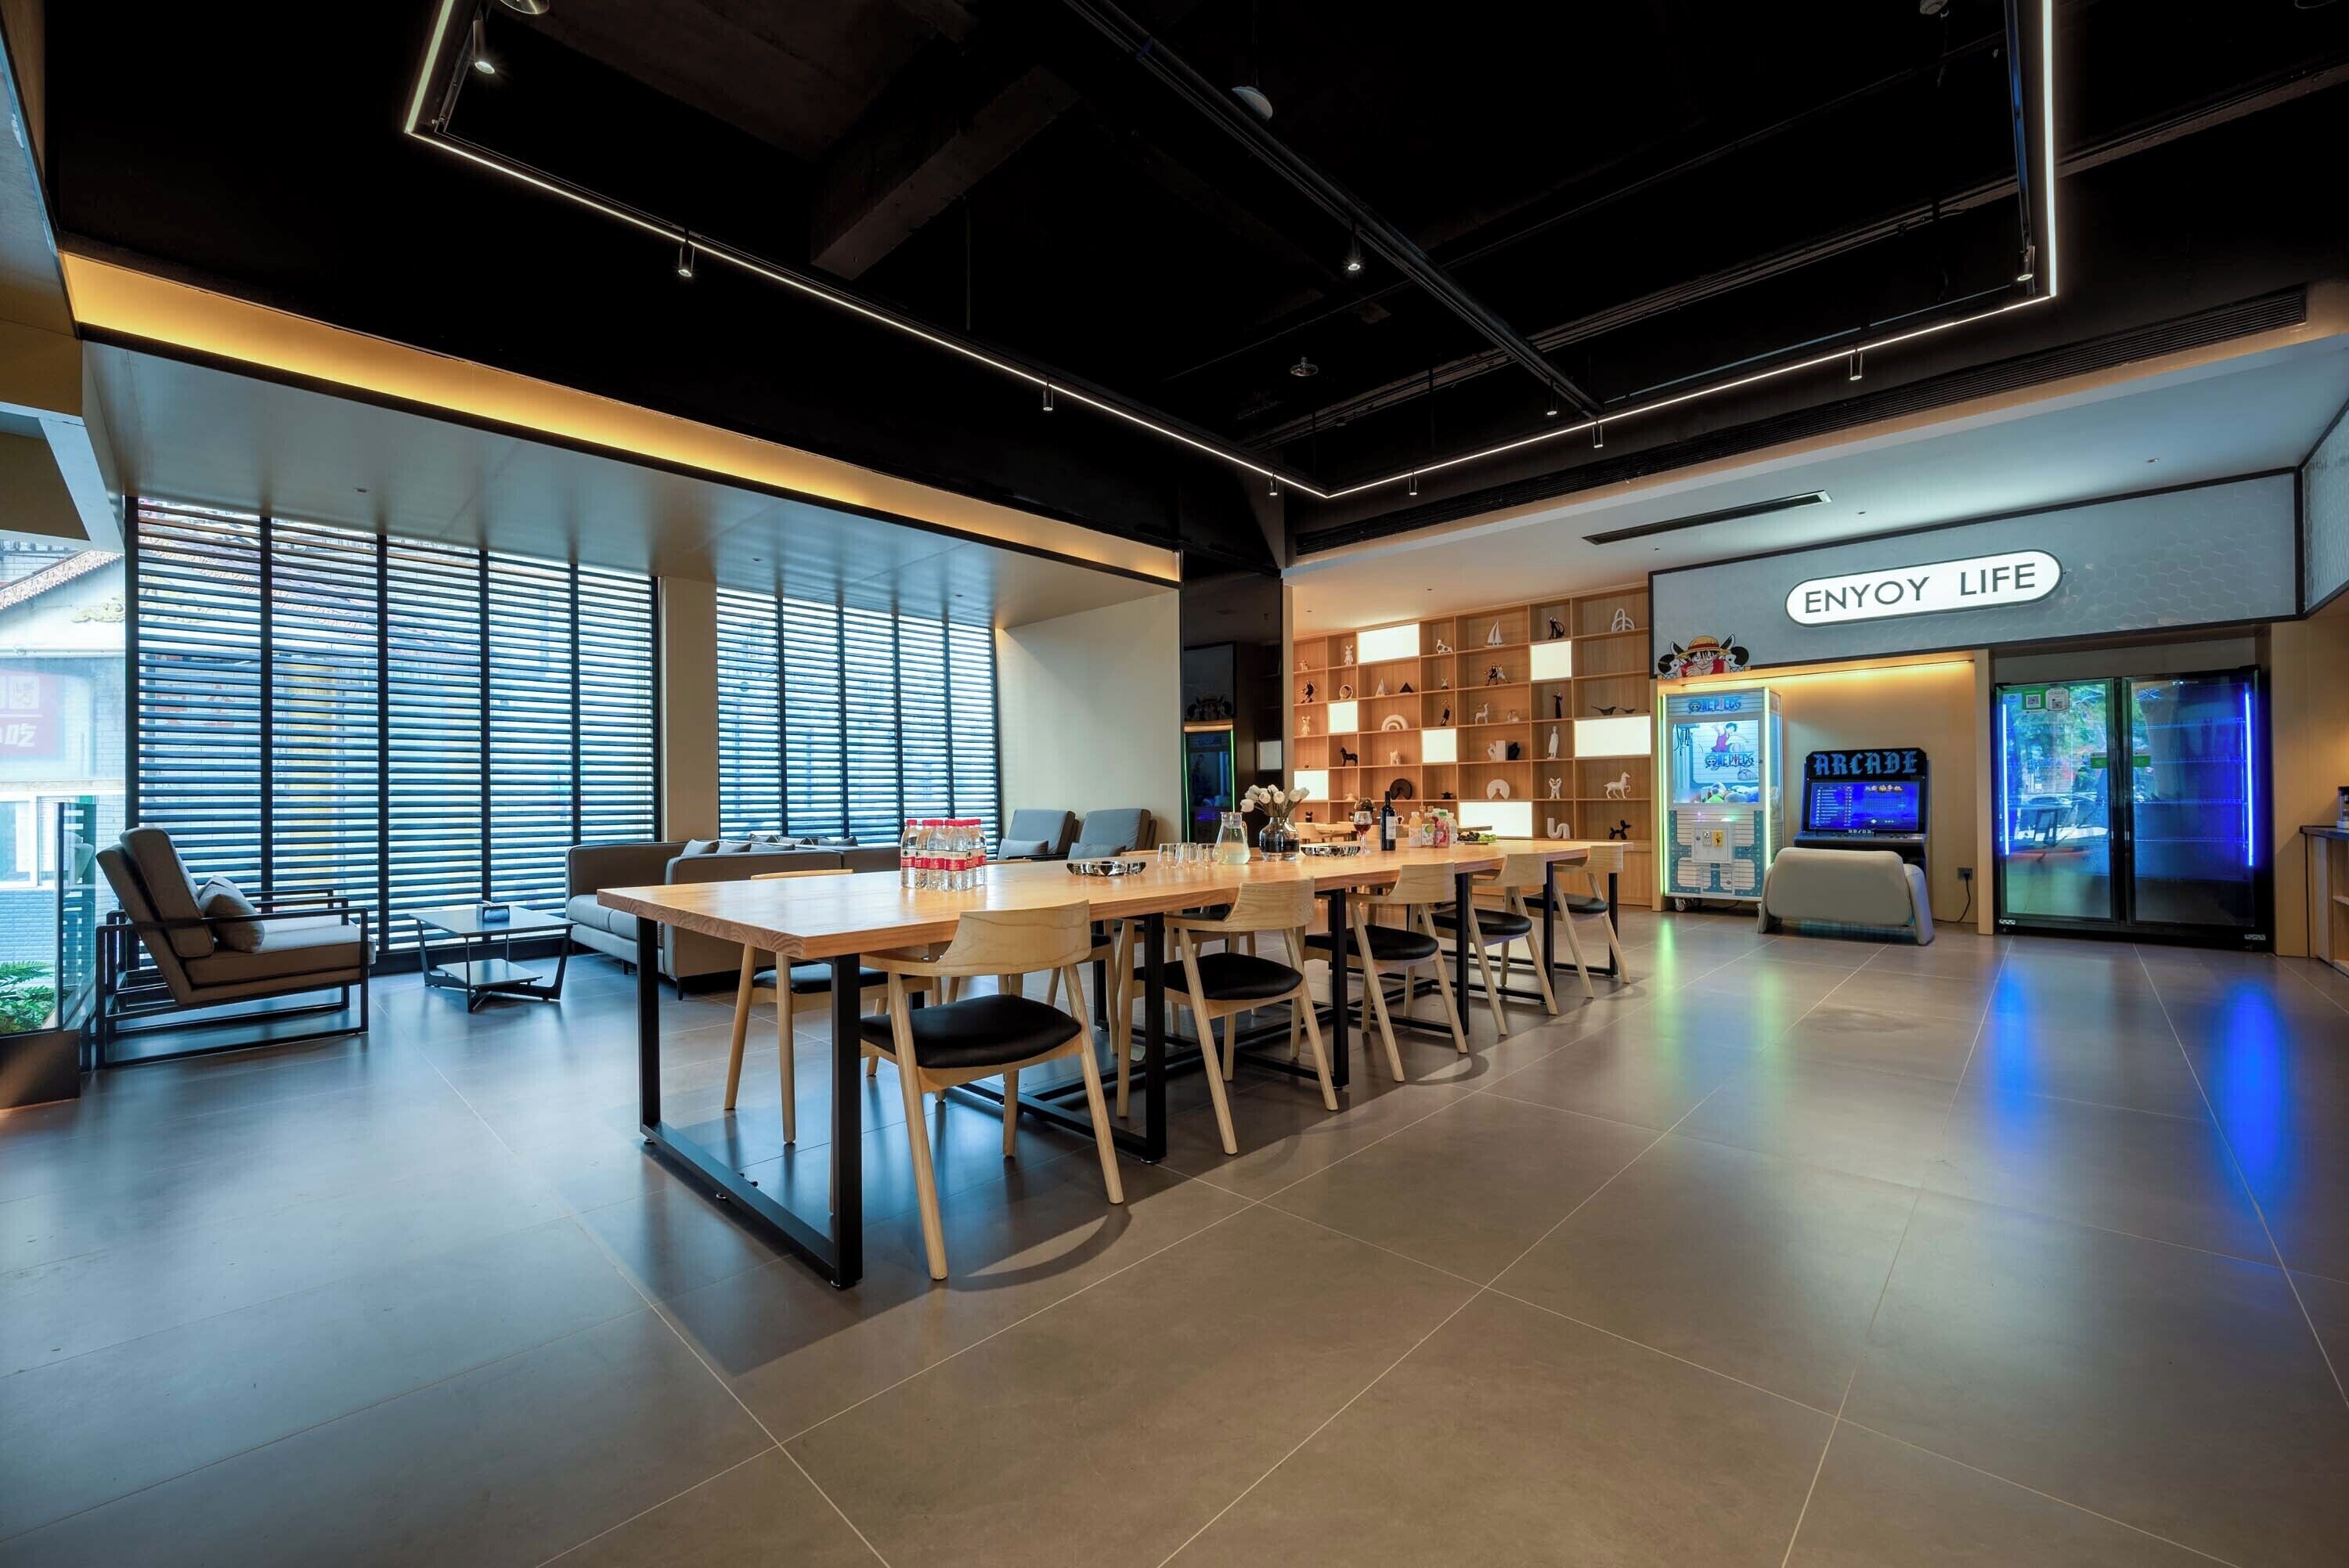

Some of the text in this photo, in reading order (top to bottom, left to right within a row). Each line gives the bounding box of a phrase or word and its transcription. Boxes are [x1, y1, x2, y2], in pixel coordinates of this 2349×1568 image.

[1805, 563, 2036, 614] ENYOY LIFE
[1813, 751, 1918, 775] ARCADE
